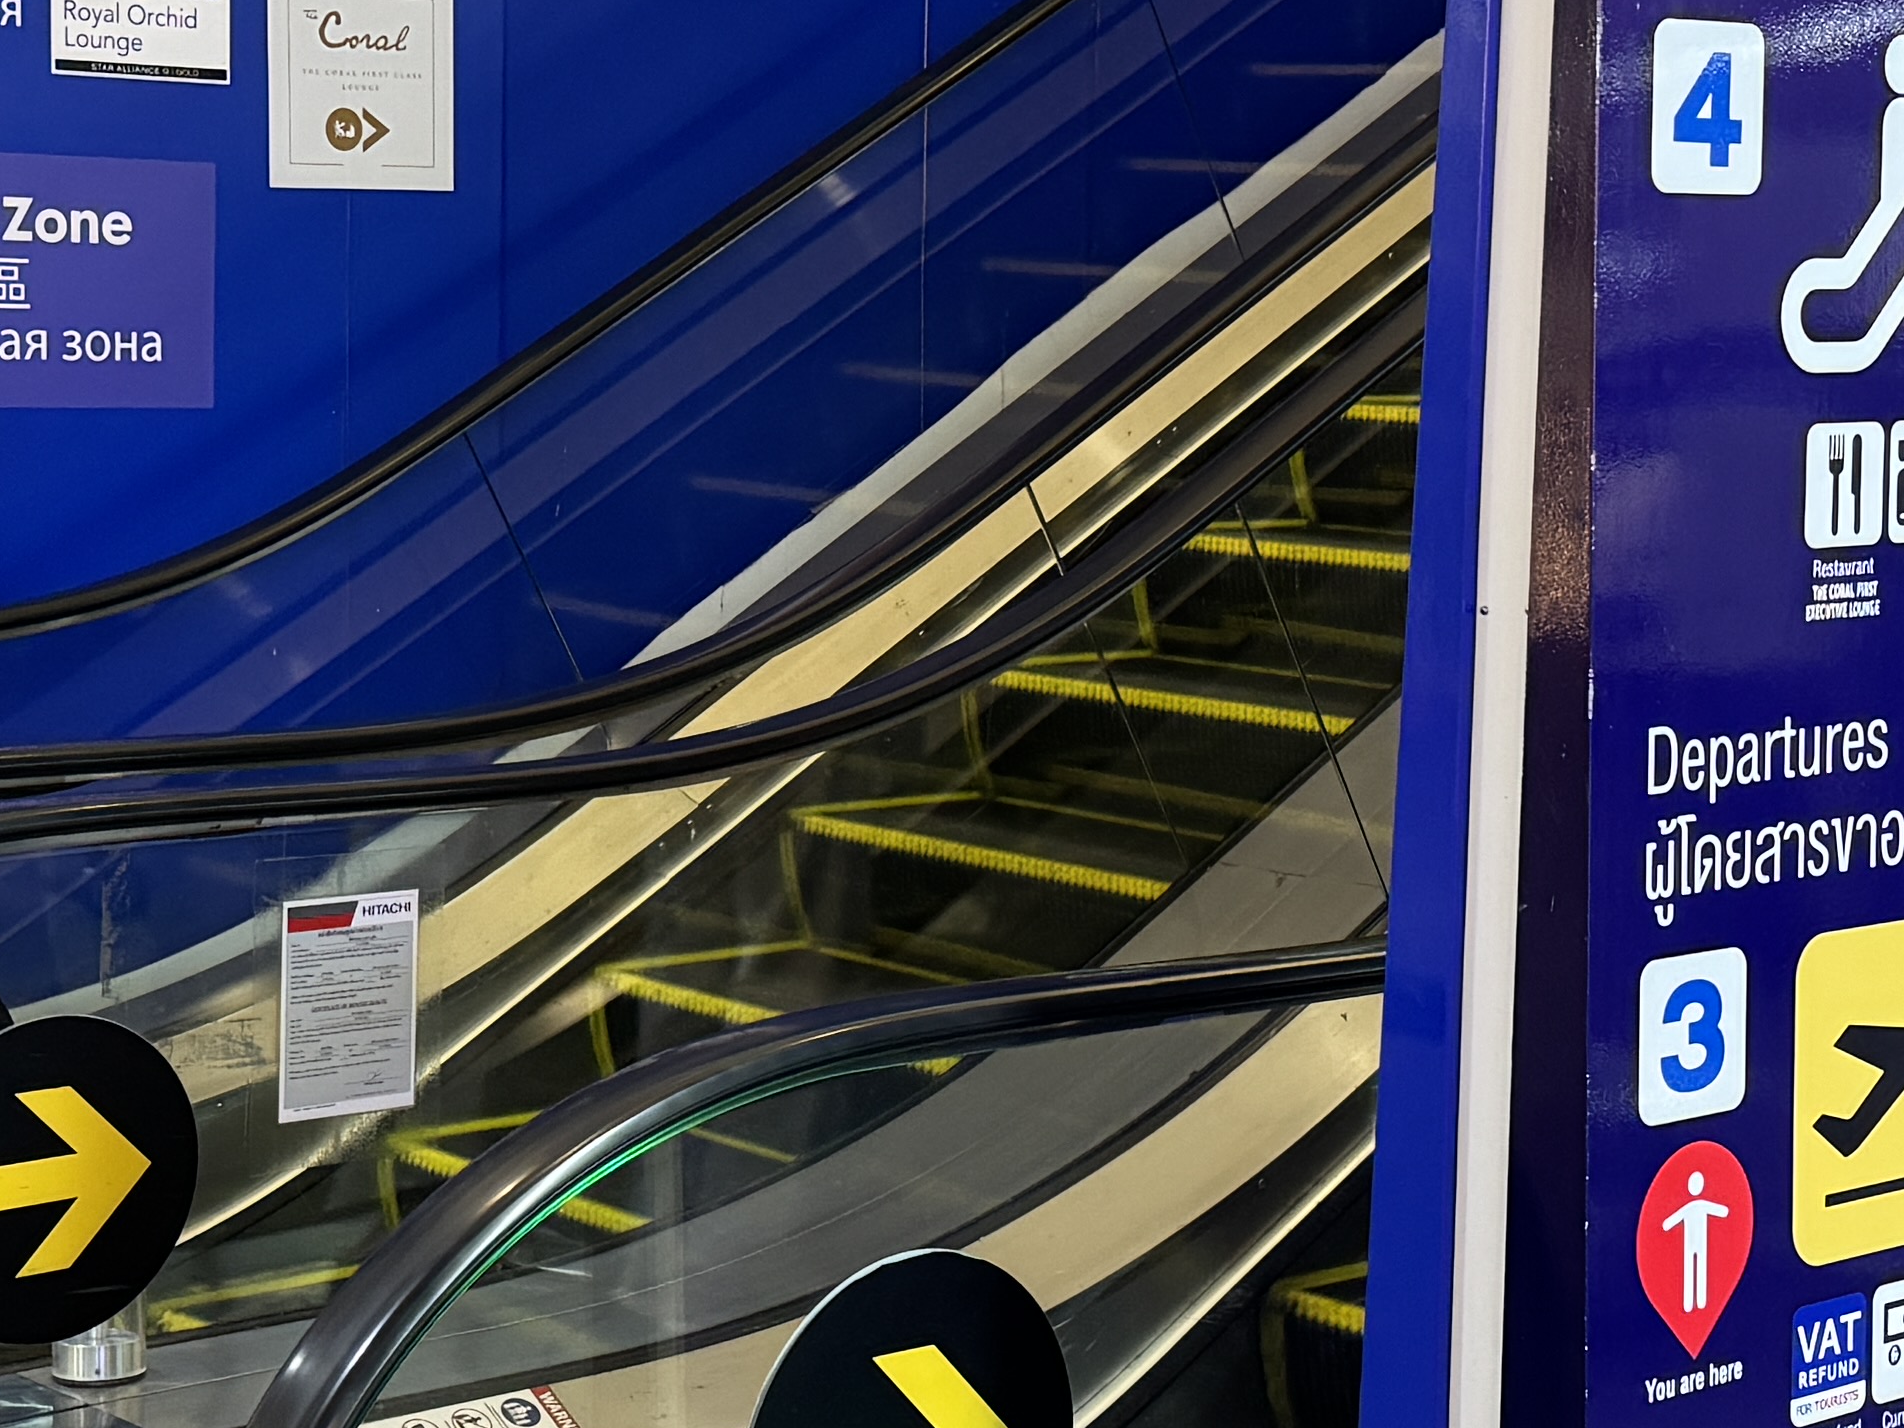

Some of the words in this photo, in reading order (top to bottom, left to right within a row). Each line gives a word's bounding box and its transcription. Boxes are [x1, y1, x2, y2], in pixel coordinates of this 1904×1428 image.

[63, 0, 119, 28] Royal
[127, 2, 197, 29] Orchid
[318, 10, 410, 51] Coral
[64, 25, 143, 57] Lounge
[1673, 51, 1743, 168] 4
[1, 196, 133, 246] Zone
[62, 328, 164, 363] зона
[1813, 557, 1874, 578] Restaurant
[1647, 716, 1889, 804] Departures
[362, 901, 411, 917] HITACHI
[1660, 978, 1725, 1093] 3
[1797, 1310, 1862, 1364] VAT
[1644, 1377, 1678, 1404] You
[1680, 1372, 1704, 1394] are
[1708, 1359, 1743, 1388] here
[1798, 1357, 1860, 1389] REFUND
